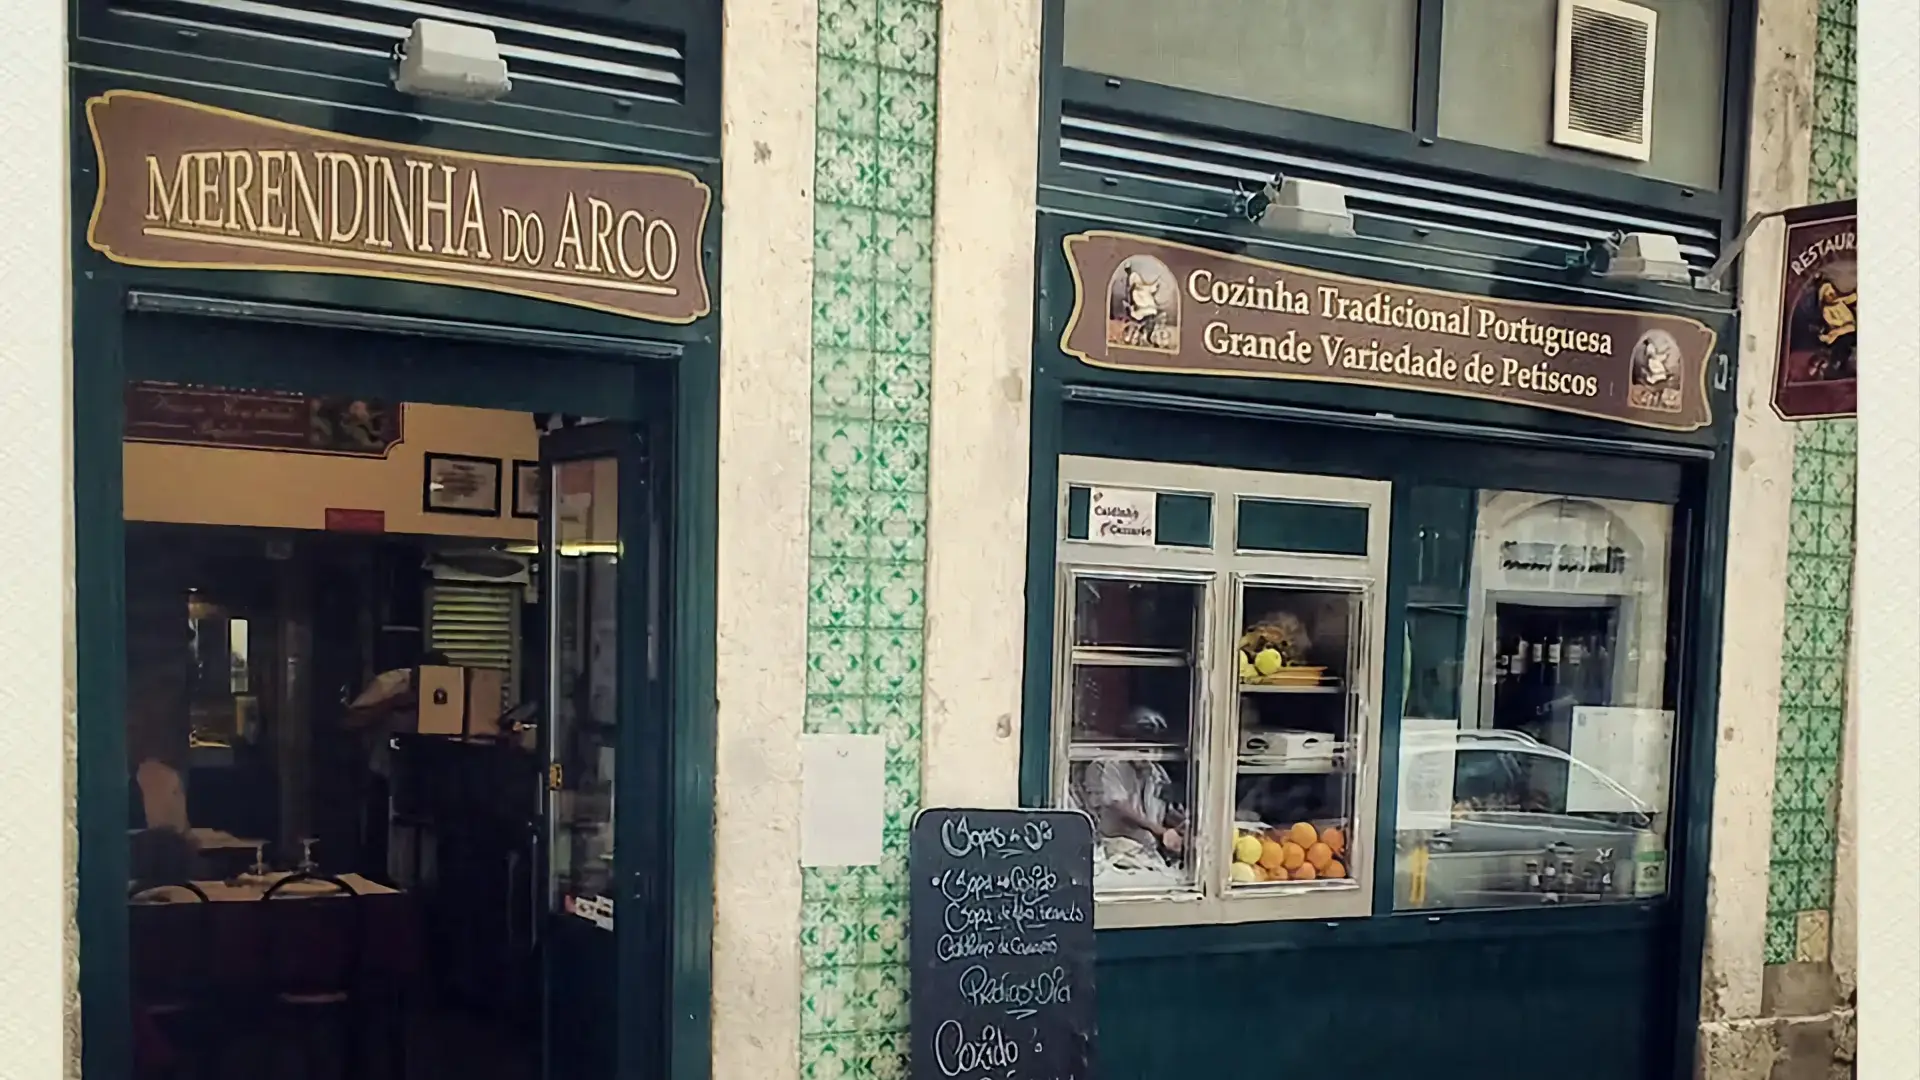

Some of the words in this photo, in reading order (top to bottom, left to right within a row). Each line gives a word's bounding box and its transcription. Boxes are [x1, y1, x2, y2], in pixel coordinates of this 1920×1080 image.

[146, 148, 491, 259] MERENDINHA
[500, 206, 544, 265] DO
[553, 191, 679, 282] ARCO
[1791, 231, 1857, 276] RESTAUR
[1187, 269, 1310, 316] Cozinha
[1317, 285, 1471, 337] Tradicional
[1477, 310, 1613, 356] Portuguesa
[1203, 321, 1312, 366] Grande
[1322, 335, 1457, 382] Variedade
[1463, 350, 1495, 384] de
[1500, 358, 1599, 397] Petiscos
[935, 1020, 1019, 1076] Cozido
